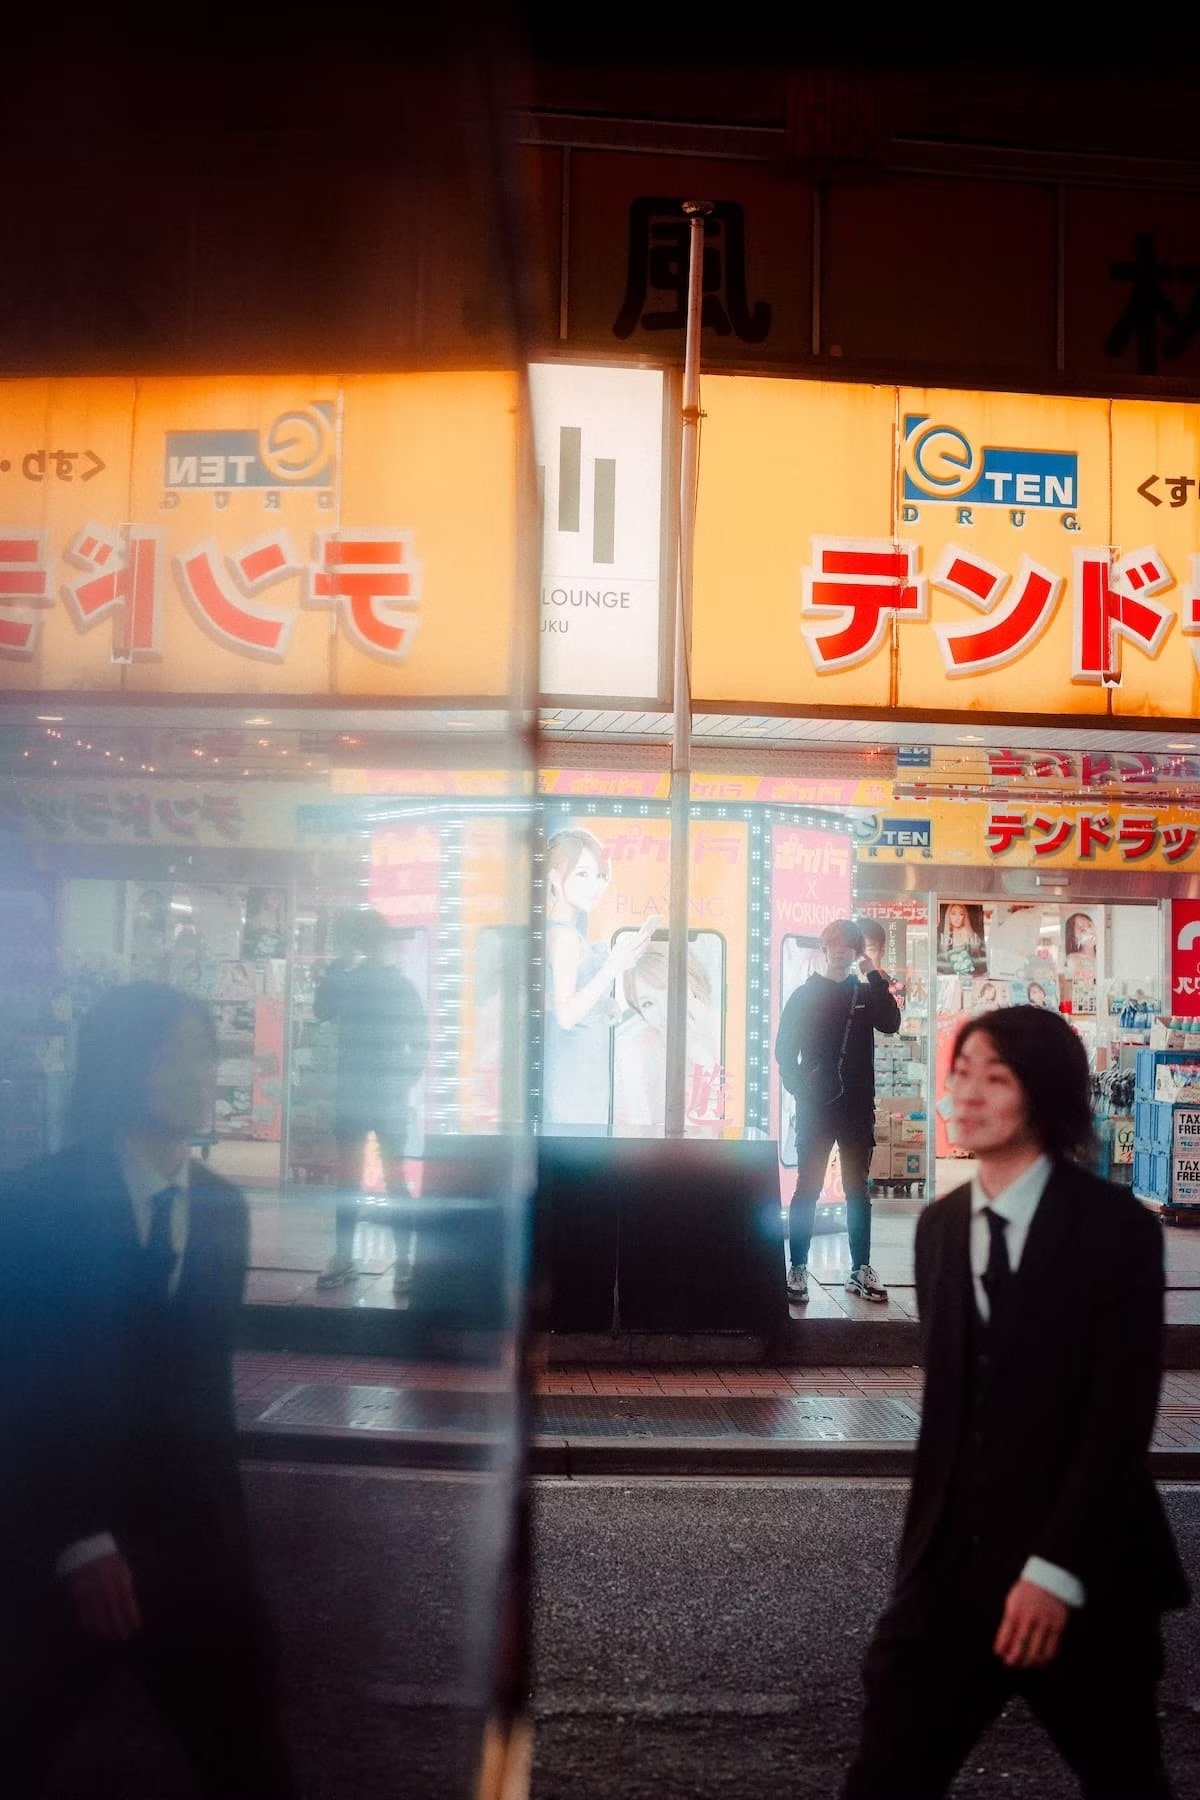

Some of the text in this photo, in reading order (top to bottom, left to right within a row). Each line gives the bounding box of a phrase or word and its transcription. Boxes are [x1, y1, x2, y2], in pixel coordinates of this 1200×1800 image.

[611, 195, 772, 345] 風
[984, 471, 1073, 506] TEN
[1136, 474, 1200, 508] くす
[541, 586, 631, 609] LOUNGE
[801, 536, 1200, 686] テンド
[883, 830, 929, 846] TEN
[616, 894, 725, 916] PLANG
[1177, 1160, 1200, 1171] TAX
